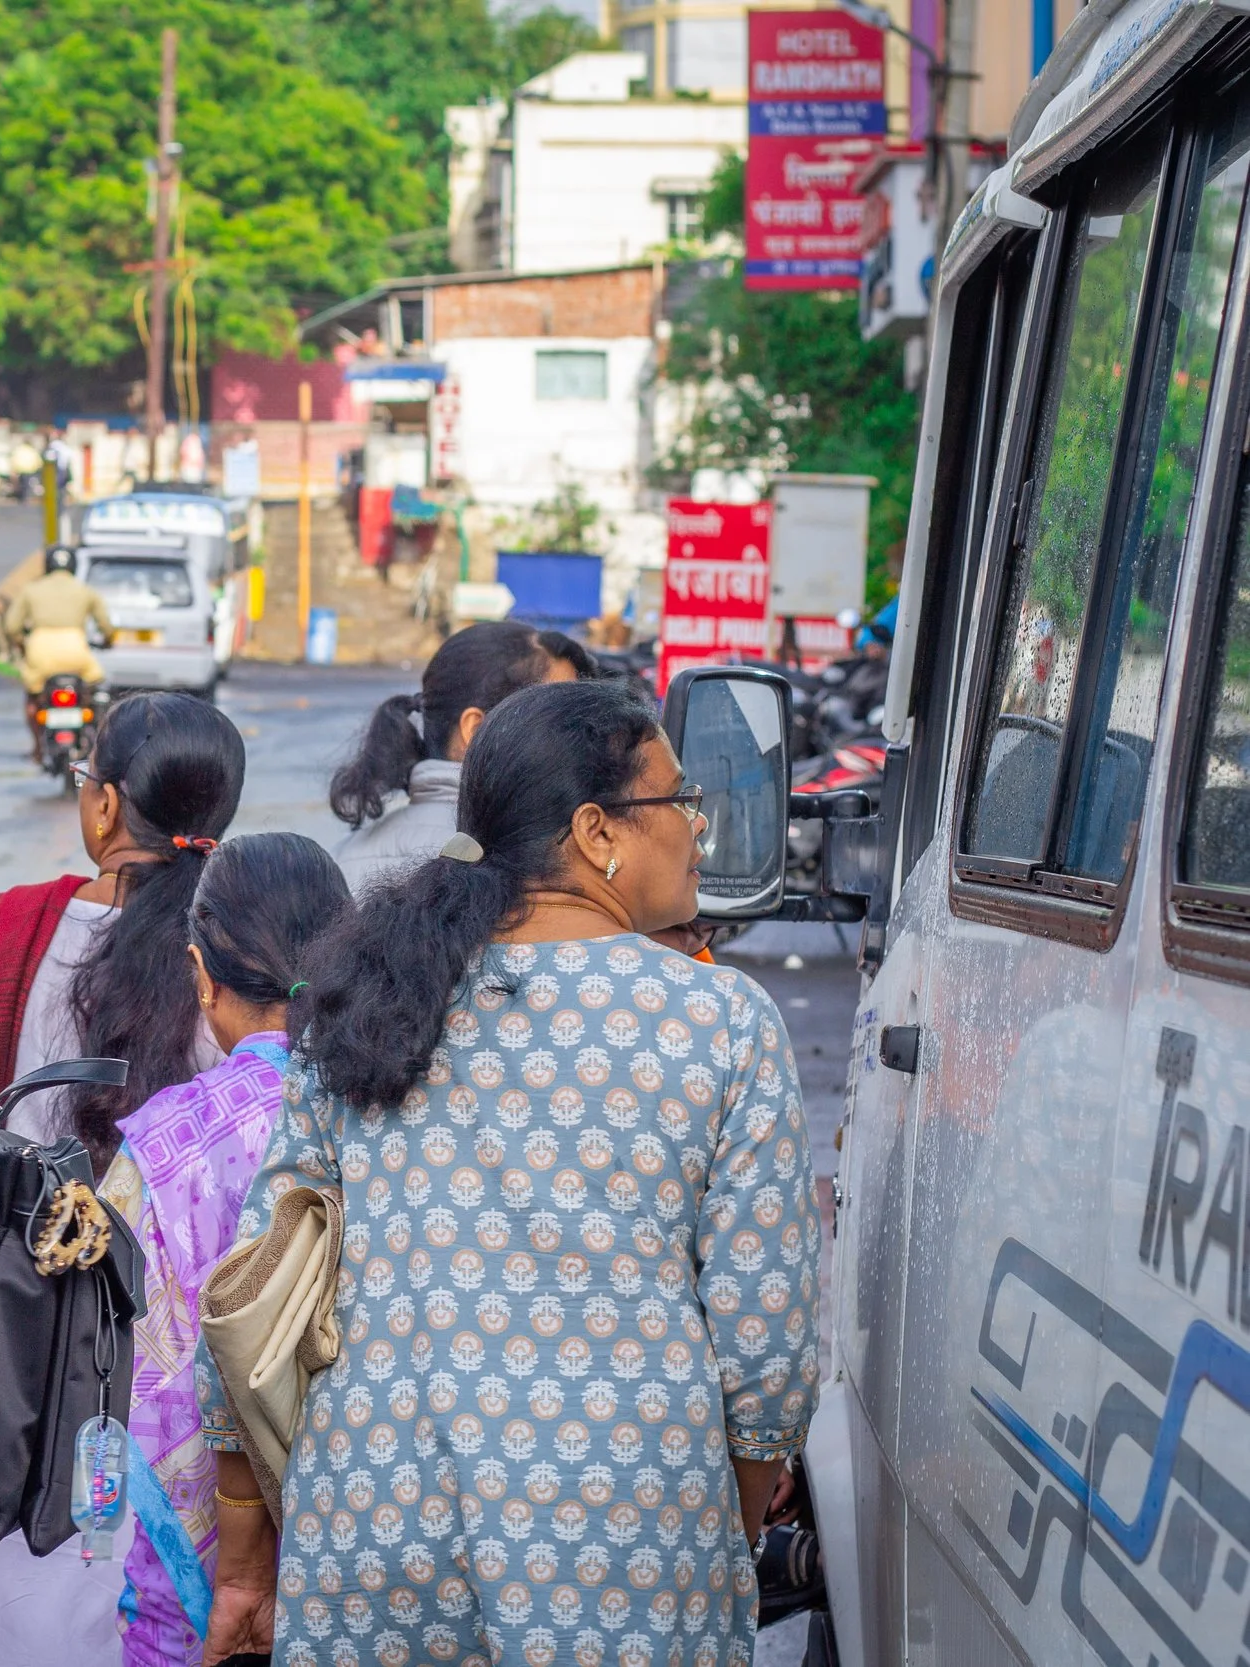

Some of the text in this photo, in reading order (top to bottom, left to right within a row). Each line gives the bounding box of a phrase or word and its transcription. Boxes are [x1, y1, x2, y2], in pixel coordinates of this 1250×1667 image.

[778, 29, 858, 57] HOTEL
[667, 542, 769, 604] पंजाबी
[701, 886, 761, 896] CLOSER THAN THEY APPEAR
[726, 878, 735, 886] THE
[735, 877, 753, 886] MIRROR
[753, 878, 762, 886] ARE
